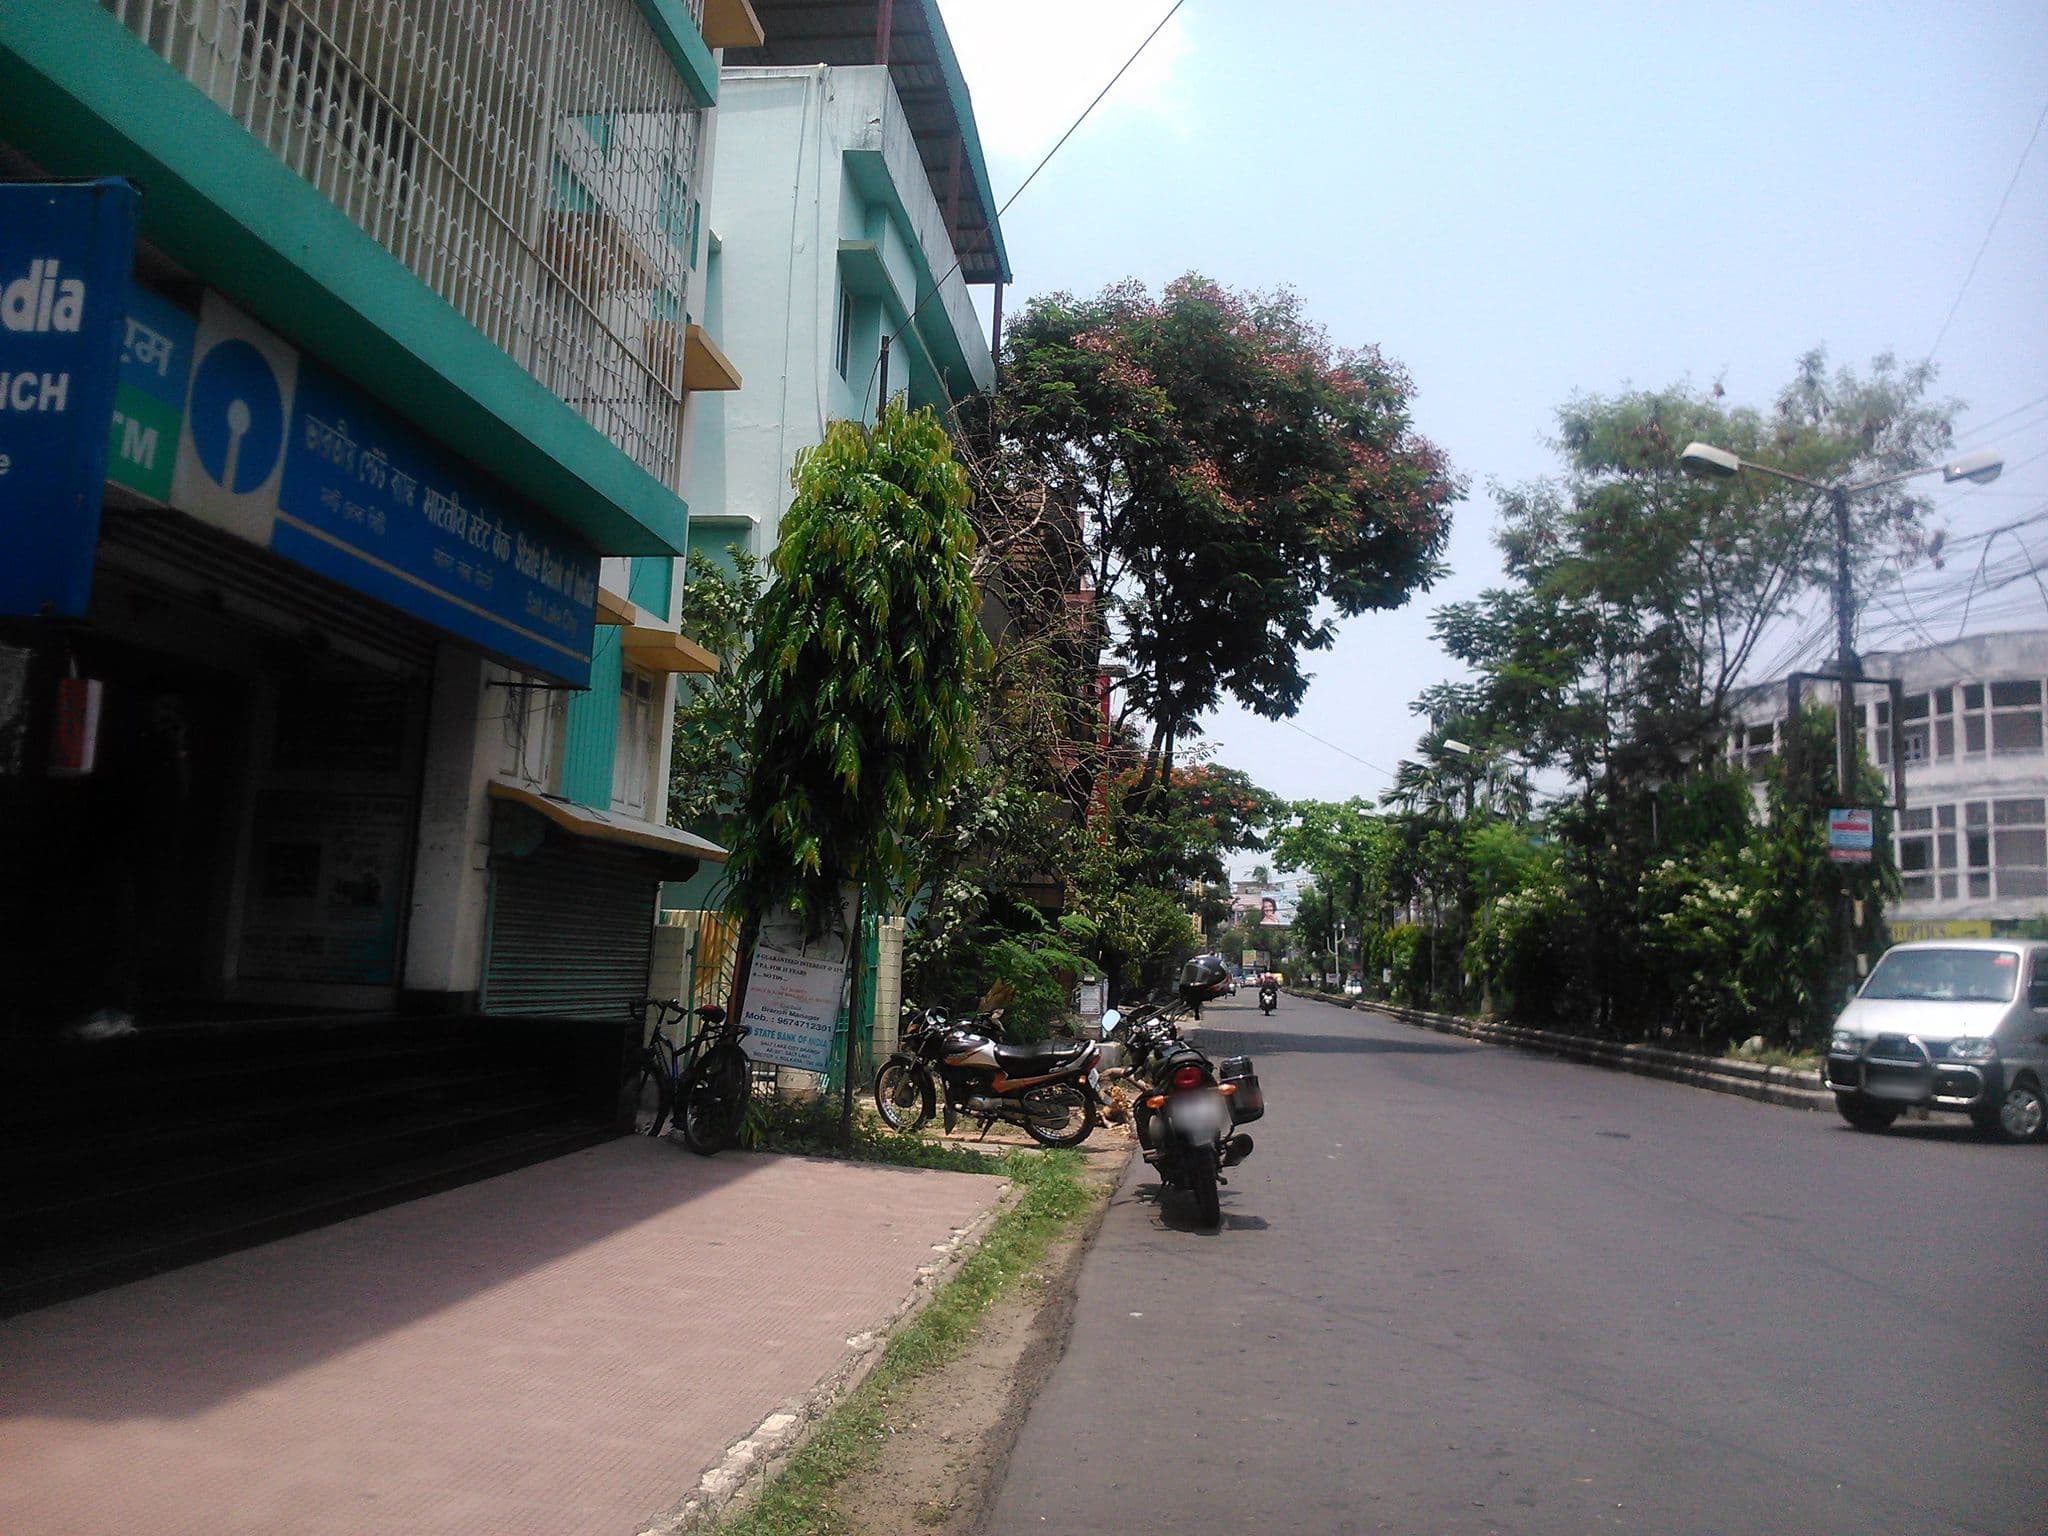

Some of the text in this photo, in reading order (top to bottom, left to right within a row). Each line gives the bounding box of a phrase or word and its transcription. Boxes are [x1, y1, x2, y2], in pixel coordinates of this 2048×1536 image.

[0, 258, 86, 332] dia
[760, 1005, 820, 1023] Branch Manager
[753, 1027, 776, 1040] STATE
[776, 1031, 796, 1043] BANK
